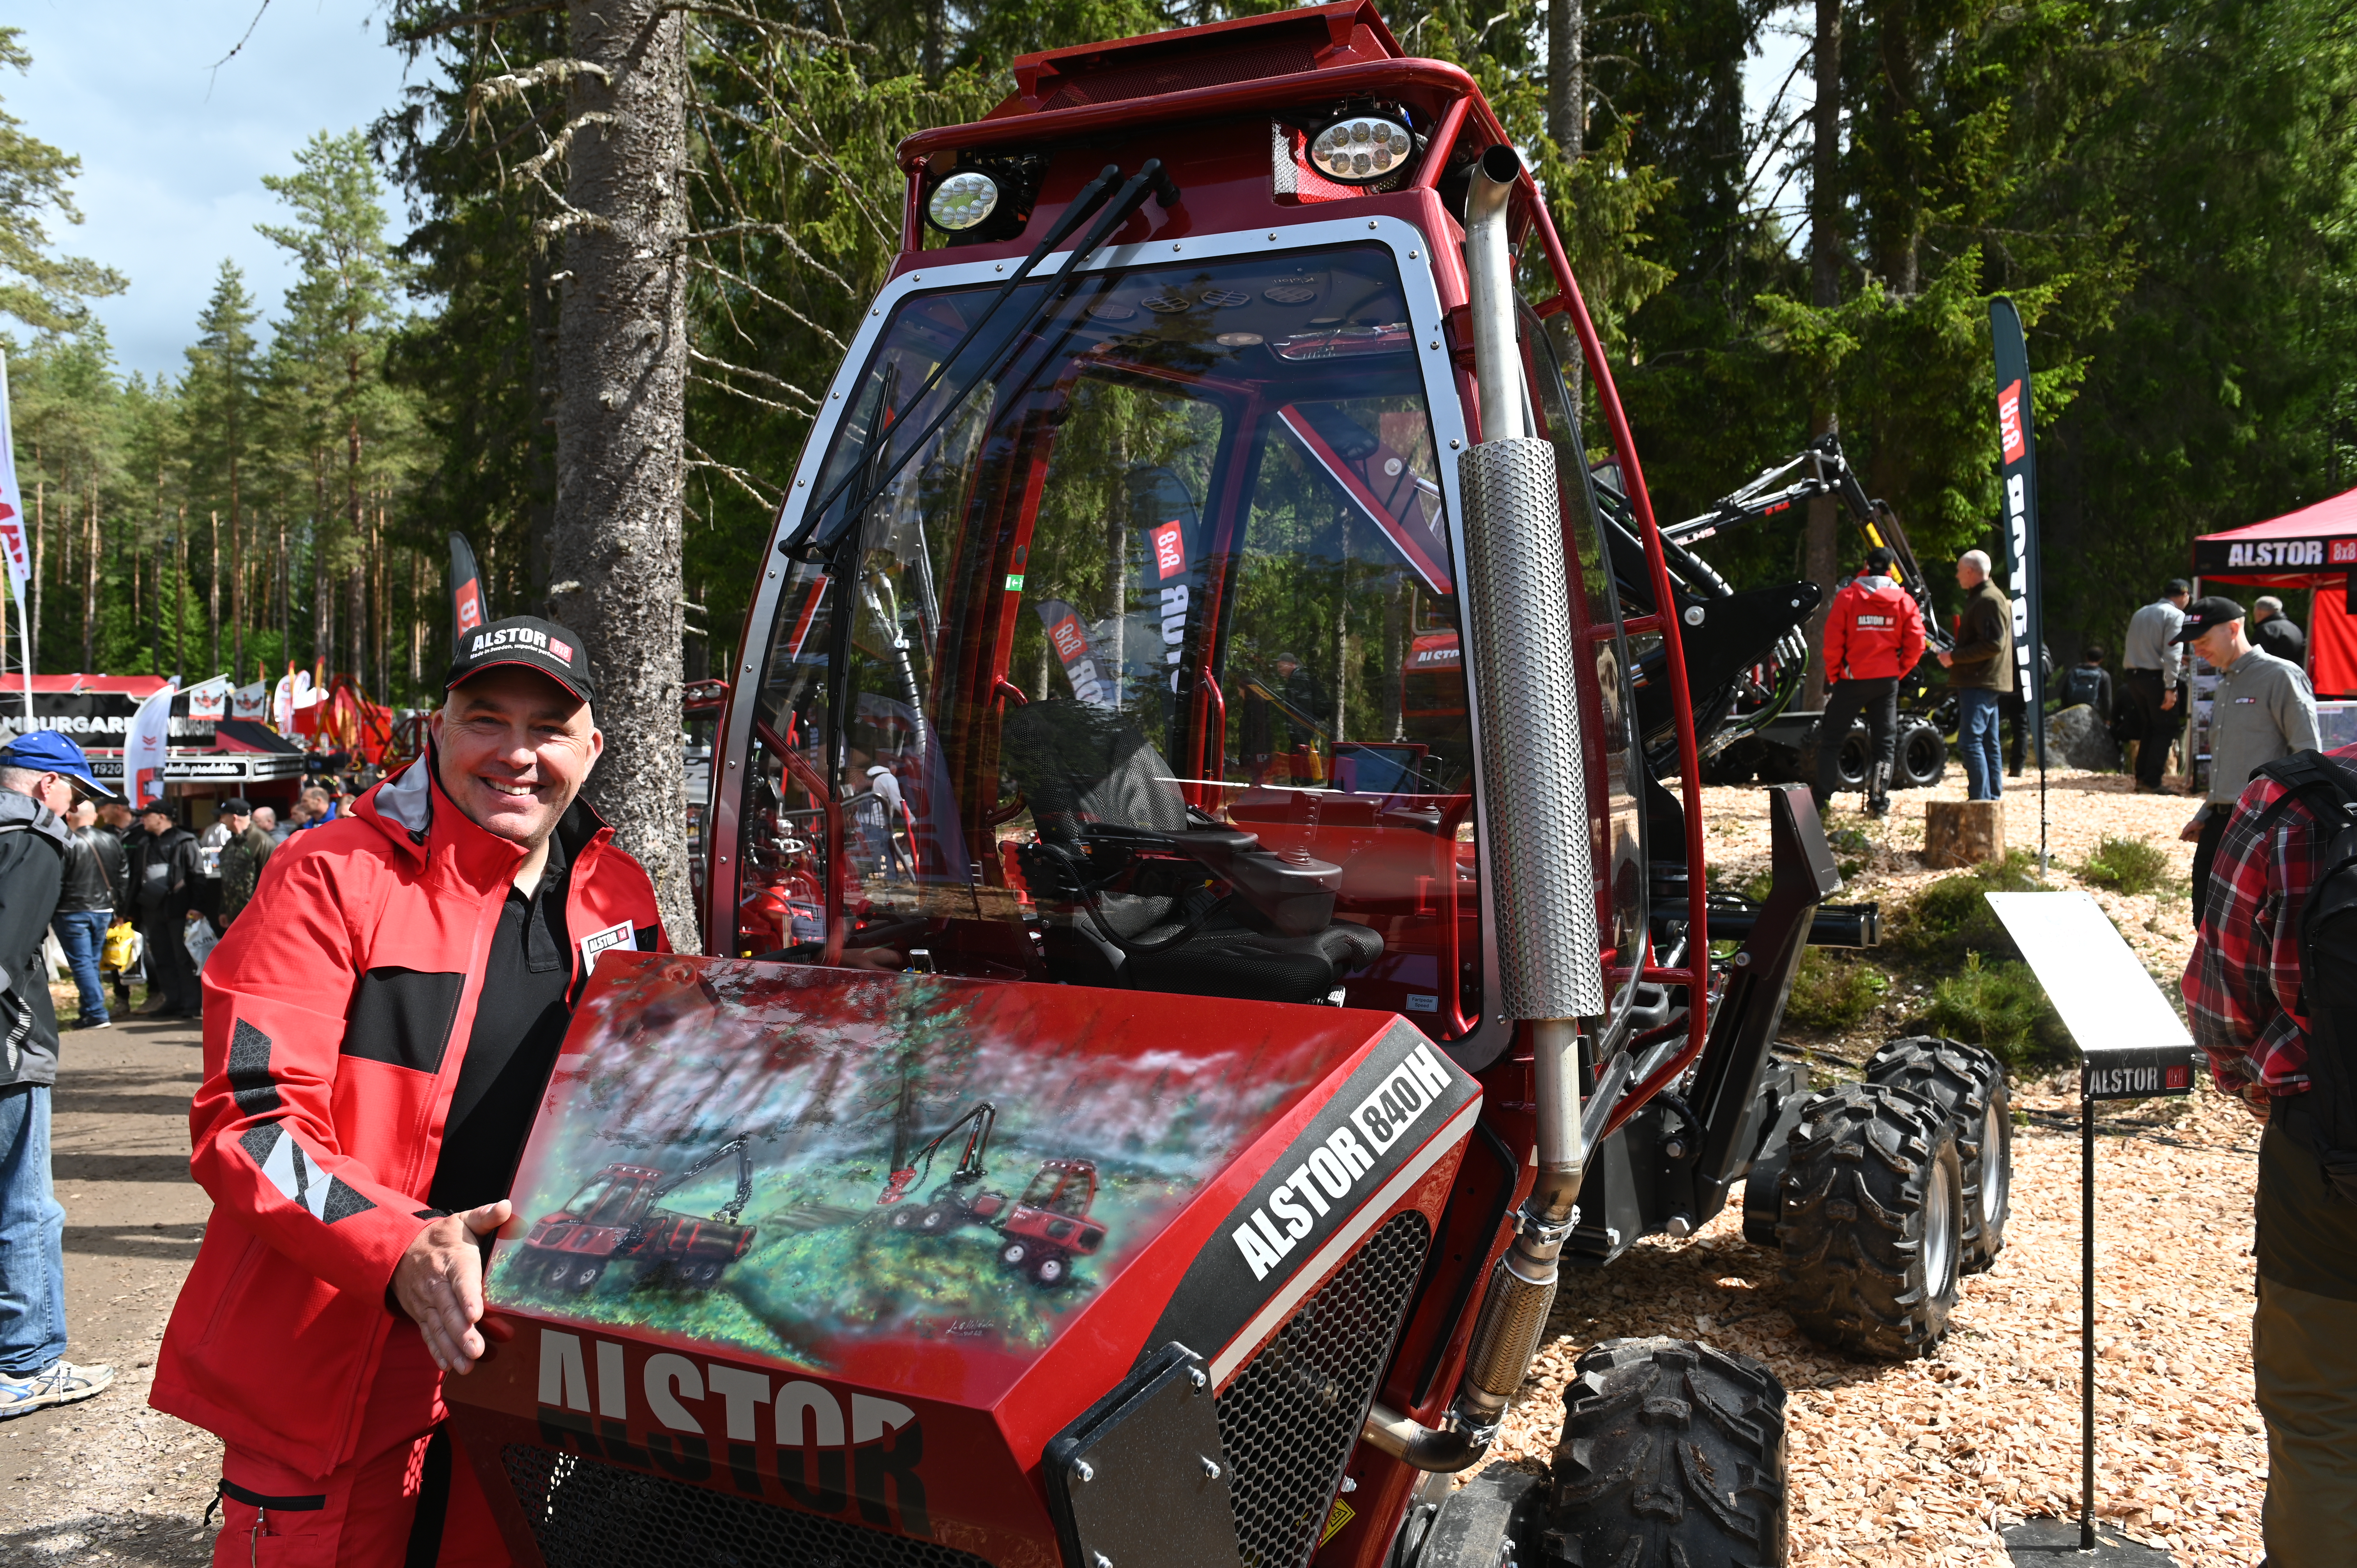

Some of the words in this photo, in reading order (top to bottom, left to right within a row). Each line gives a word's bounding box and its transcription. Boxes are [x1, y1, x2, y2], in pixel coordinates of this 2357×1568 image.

[1673, 526, 1716, 546] ALMS
[2228, 540, 2323, 567] ALSTOR
[2333, 542, 2357, 561] 8x8
[472, 628, 546, 652] ALSTOR
[553, 641, 569, 658] 8x8
[470, 651, 484, 659] Made
[514, 644, 538, 652] superior
[538, 648, 571, 669] performance.
[1416, 649, 1461, 667] ALSTO
[93, 764, 123, 775] 1920
[589, 932, 618, 953] ALSTOR
[2089, 1067, 2159, 1094] ALSTOR
[2168, 1068, 2184, 1085] 8x8
[1232, 1126, 1375, 1282] ALSTOR
[1362, 1042, 1452, 1142] 840H
[537, 1328, 933, 1538] ALSTOR
